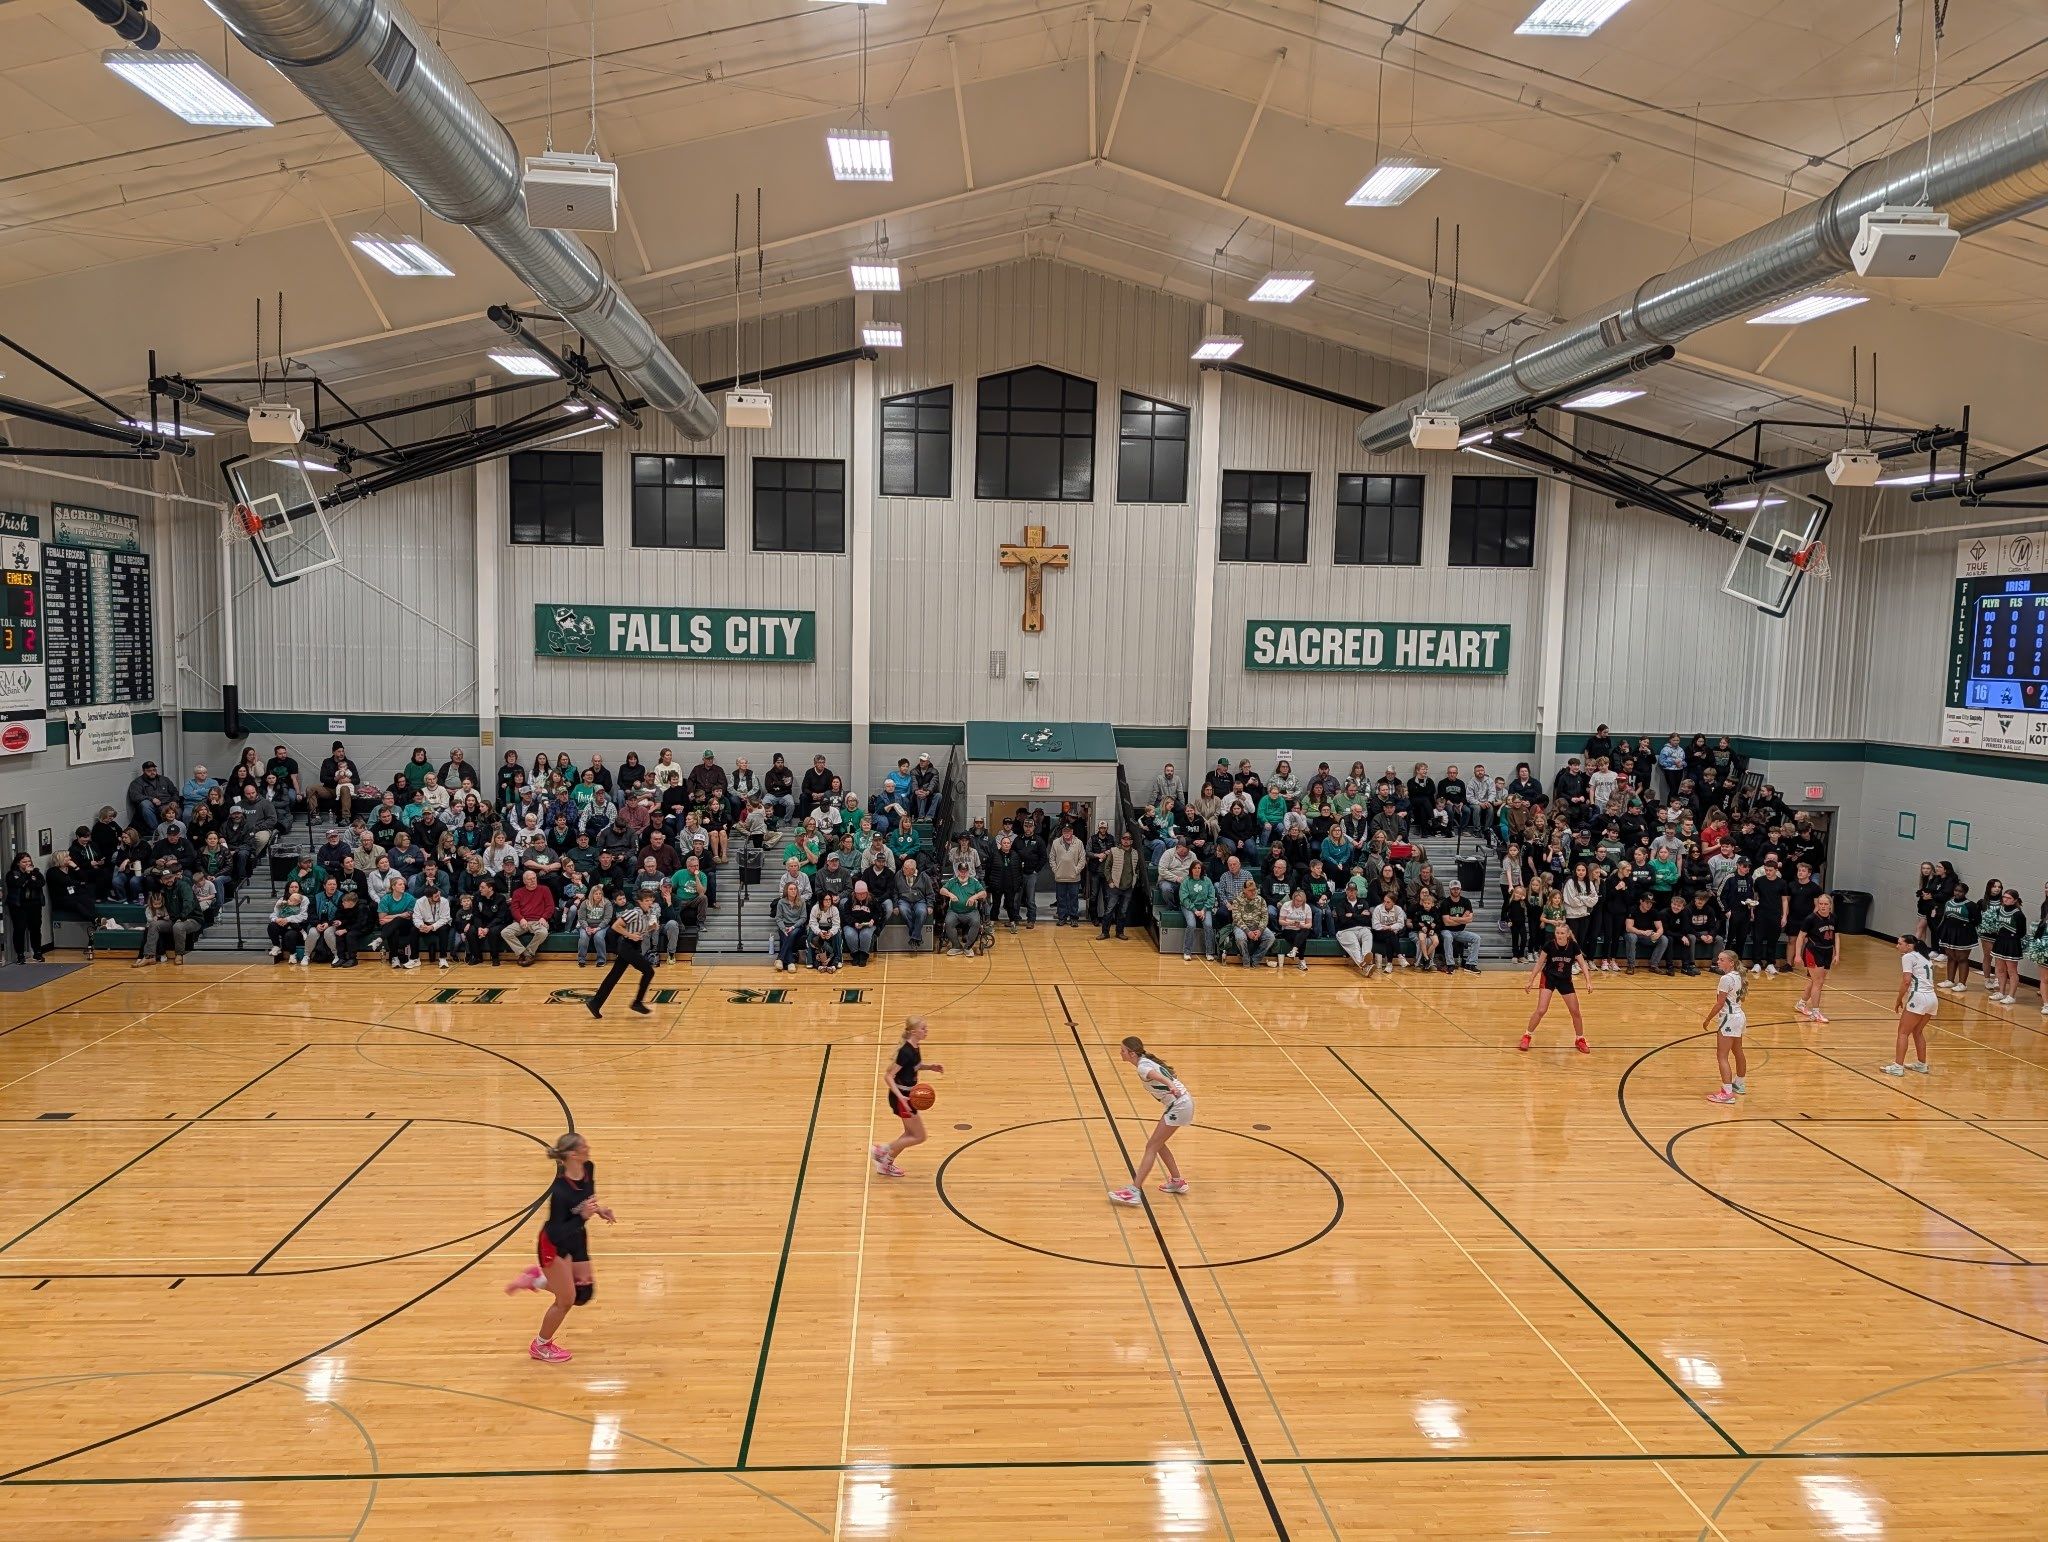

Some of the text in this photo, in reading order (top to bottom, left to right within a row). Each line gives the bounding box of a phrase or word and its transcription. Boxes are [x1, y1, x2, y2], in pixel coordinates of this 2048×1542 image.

[0, 512, 29, 532] Irish
[55, 506, 138, 531] SACRED HEART
[46, 547, 86, 560] FEMALE RECORDS
[114, 554, 145, 566] MALE RECORDS
[1966, 562, 1988, 572] TRUE
[7, 572, 33, 586] EAGLES
[2006, 580, 2030, 592] IRISH
[24, 590, 36, 616] 3
[1982, 599, 2000, 608] PLYR
[2010, 598, 2022, 608] FLS
[1958, 583, 1968, 644] FALLS
[1984, 610, 2044, 622] 00 0 0
[20, 619, 36, 628] FOULS
[1986, 625, 1992, 634] 2
[5, 630, 36, 652] 3 2
[609, 614, 802, 655] FALLS CITY
[1254, 626, 1500, 668] SACRED HEART
[1983, 638, 1992, 648] 10
[2036, 638, 2042, 648] 6
[22, 654, 38, 662] SCORE
[1983, 651, 2041, 662] 11 0 2
[1980, 664, 1990, 674] 31
[2007, 665, 2014, 674] 0
[1954, 654, 1962, 702] CITY
[1975, 685, 1987, 700] 16
[415, 988, 873, 1004] IRISH
